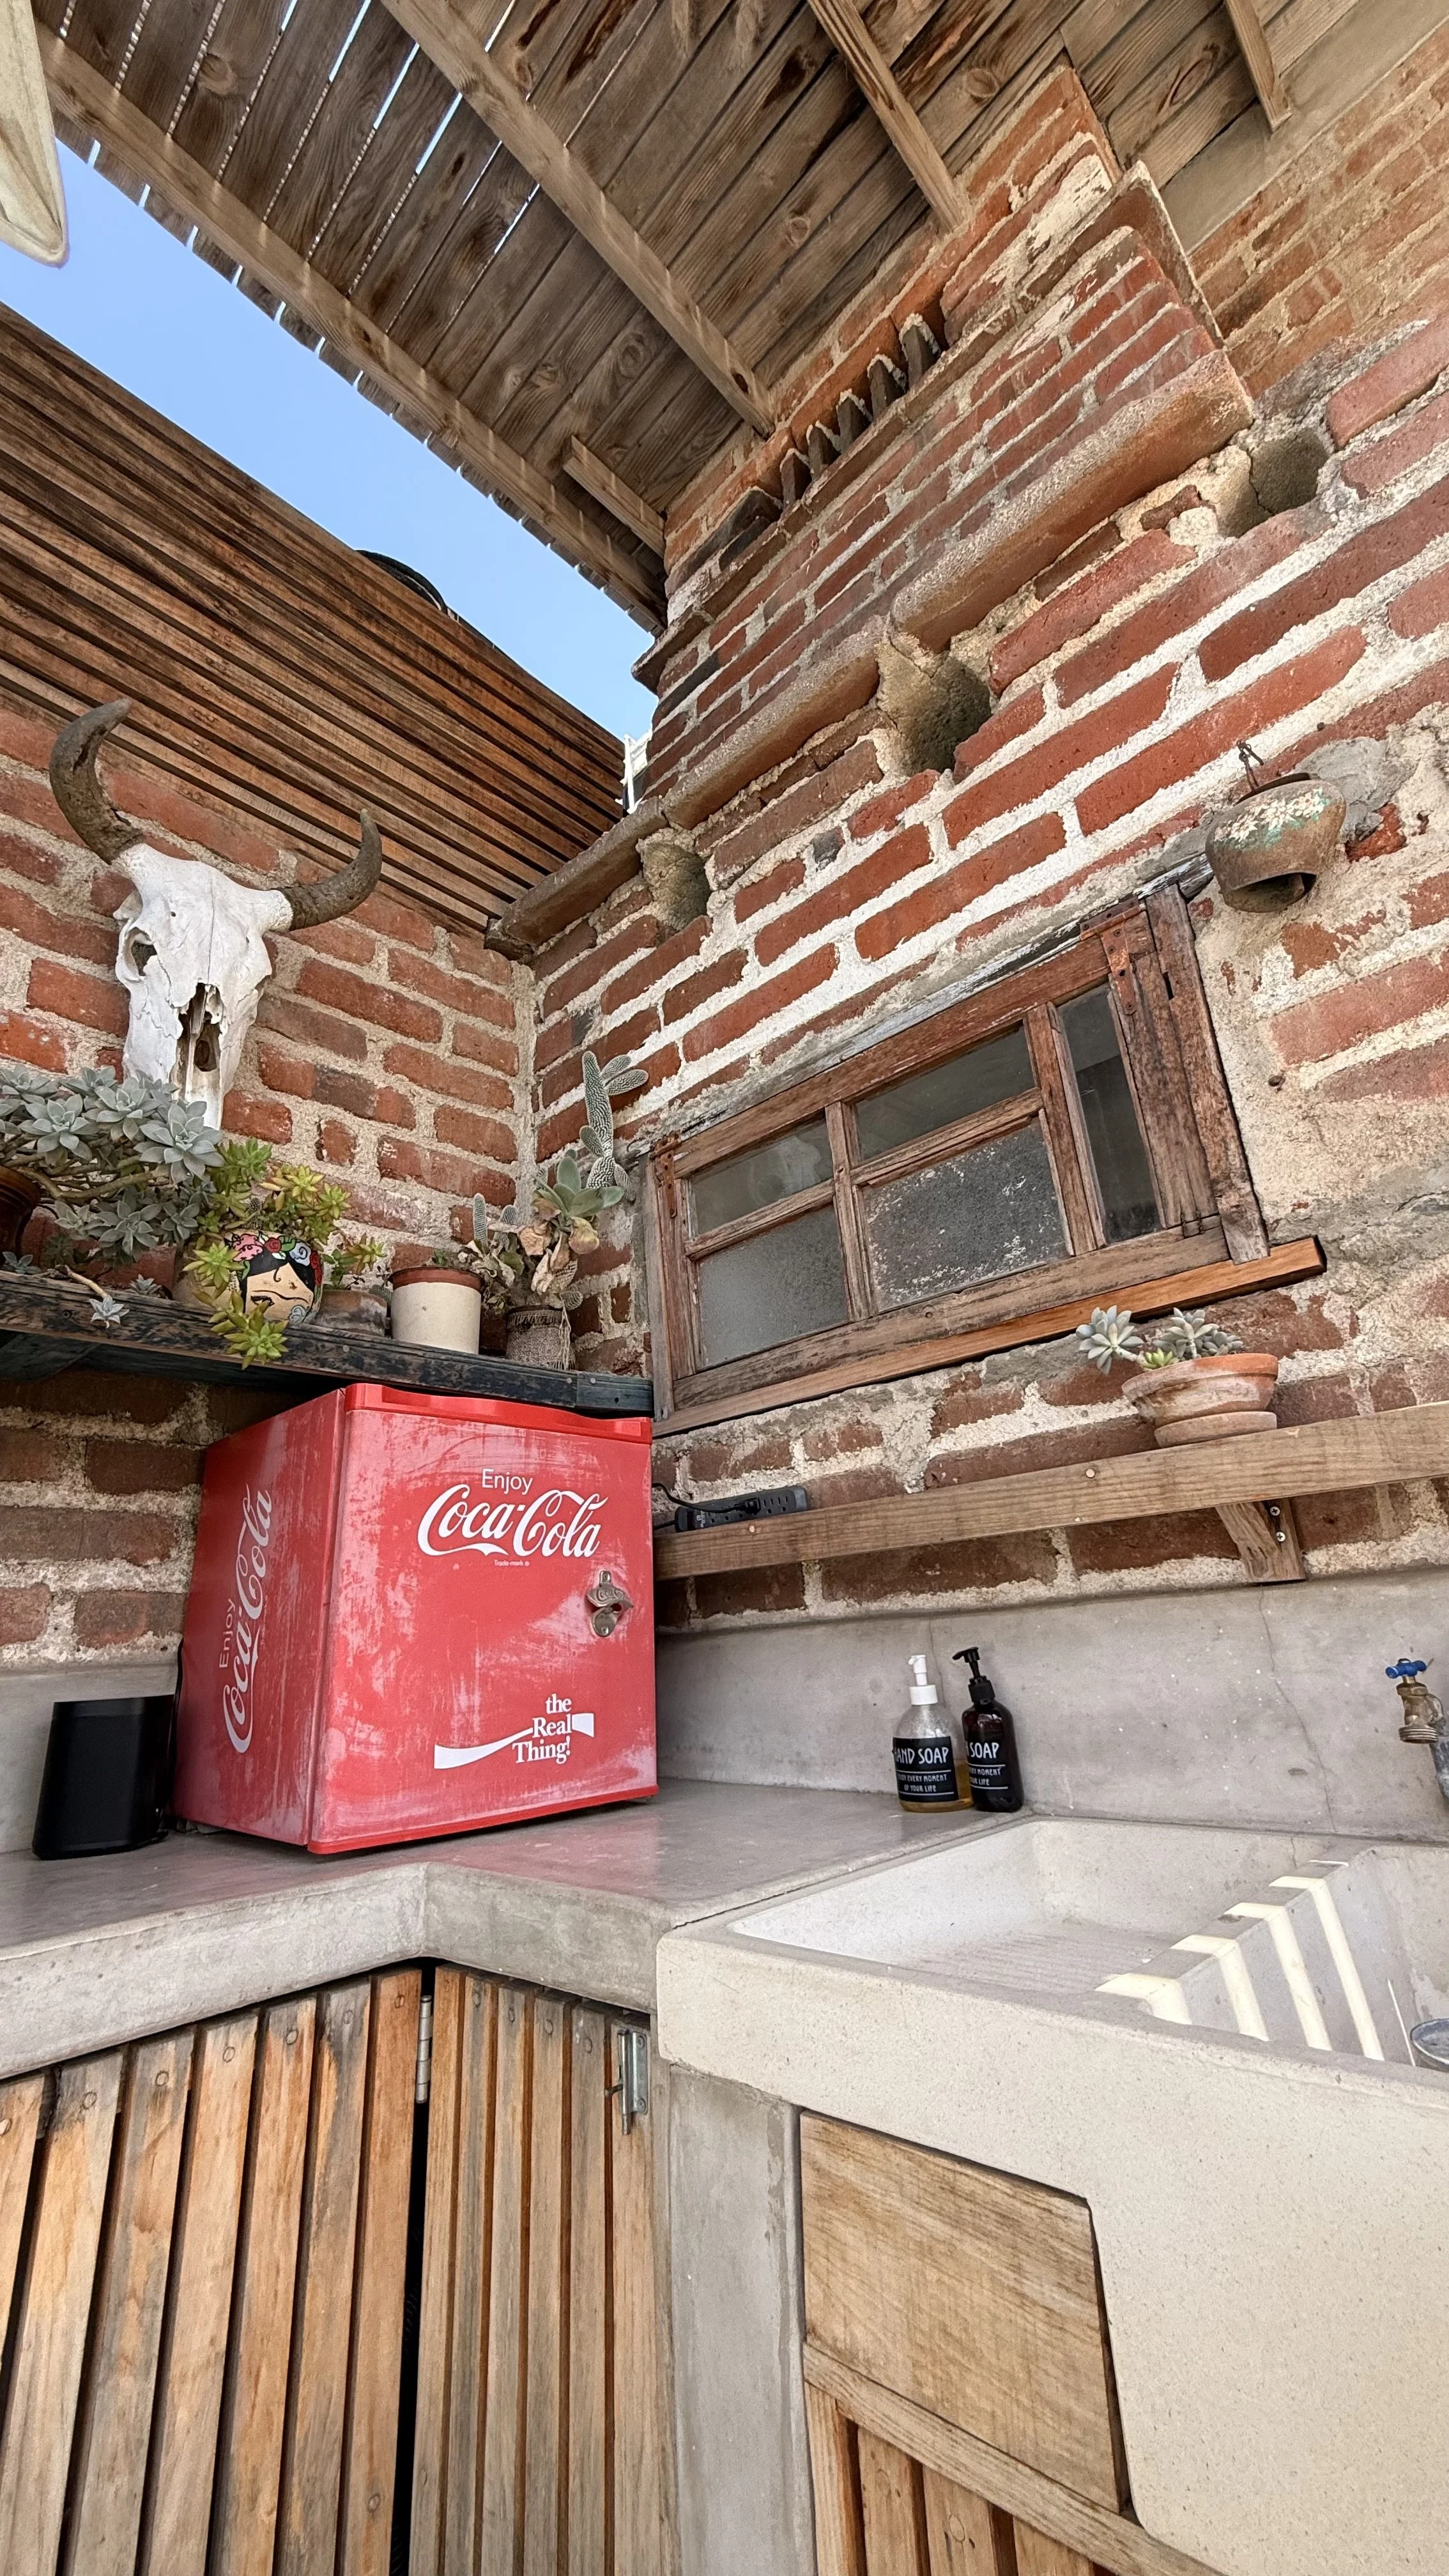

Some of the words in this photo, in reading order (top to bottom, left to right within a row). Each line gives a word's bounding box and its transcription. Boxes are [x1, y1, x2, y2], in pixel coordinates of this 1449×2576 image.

[482, 1468, 533, 1495] Enjoy
[417, 1483, 608, 1558] Coca-Cola
[222, 1483, 273, 1754] Coca-Cola
[218, 1598, 236, 1669] Enjoy
[545, 1693, 572, 1713] the
[533, 1714, 572, 1737] Real
[512, 1735, 571, 1765] Thing!
[917, 1747, 949, 1765] SOAP
[969, 1742, 999, 1759] SOAP
[923, 1774, 947, 1782] MOMENT
[977, 1767, 1001, 1775] MOMENT
